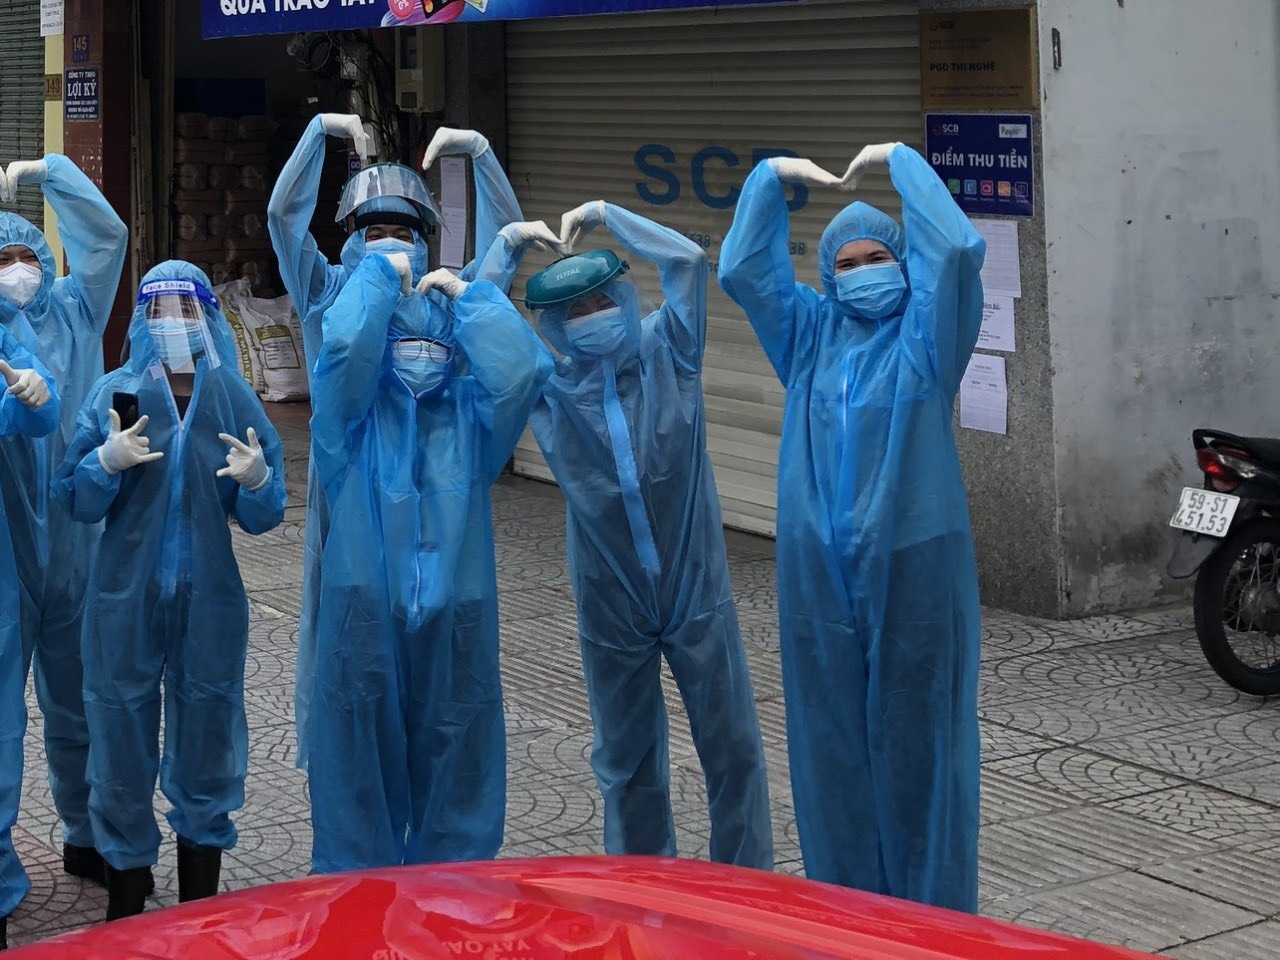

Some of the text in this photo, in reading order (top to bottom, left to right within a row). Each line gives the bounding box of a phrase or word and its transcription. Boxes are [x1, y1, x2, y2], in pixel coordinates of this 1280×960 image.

[398, 0, 410, 11] 0%
[73, 36, 87, 52] 145
[68, 79, 97, 99] LỢI KÝ
[942, 124, 959, 133] SCB
[932, 146, 1028, 168] ĐIỂM THU TIỀN
[556, 268, 580, 280] TOTAL
[164, 282, 192, 290] Shield
